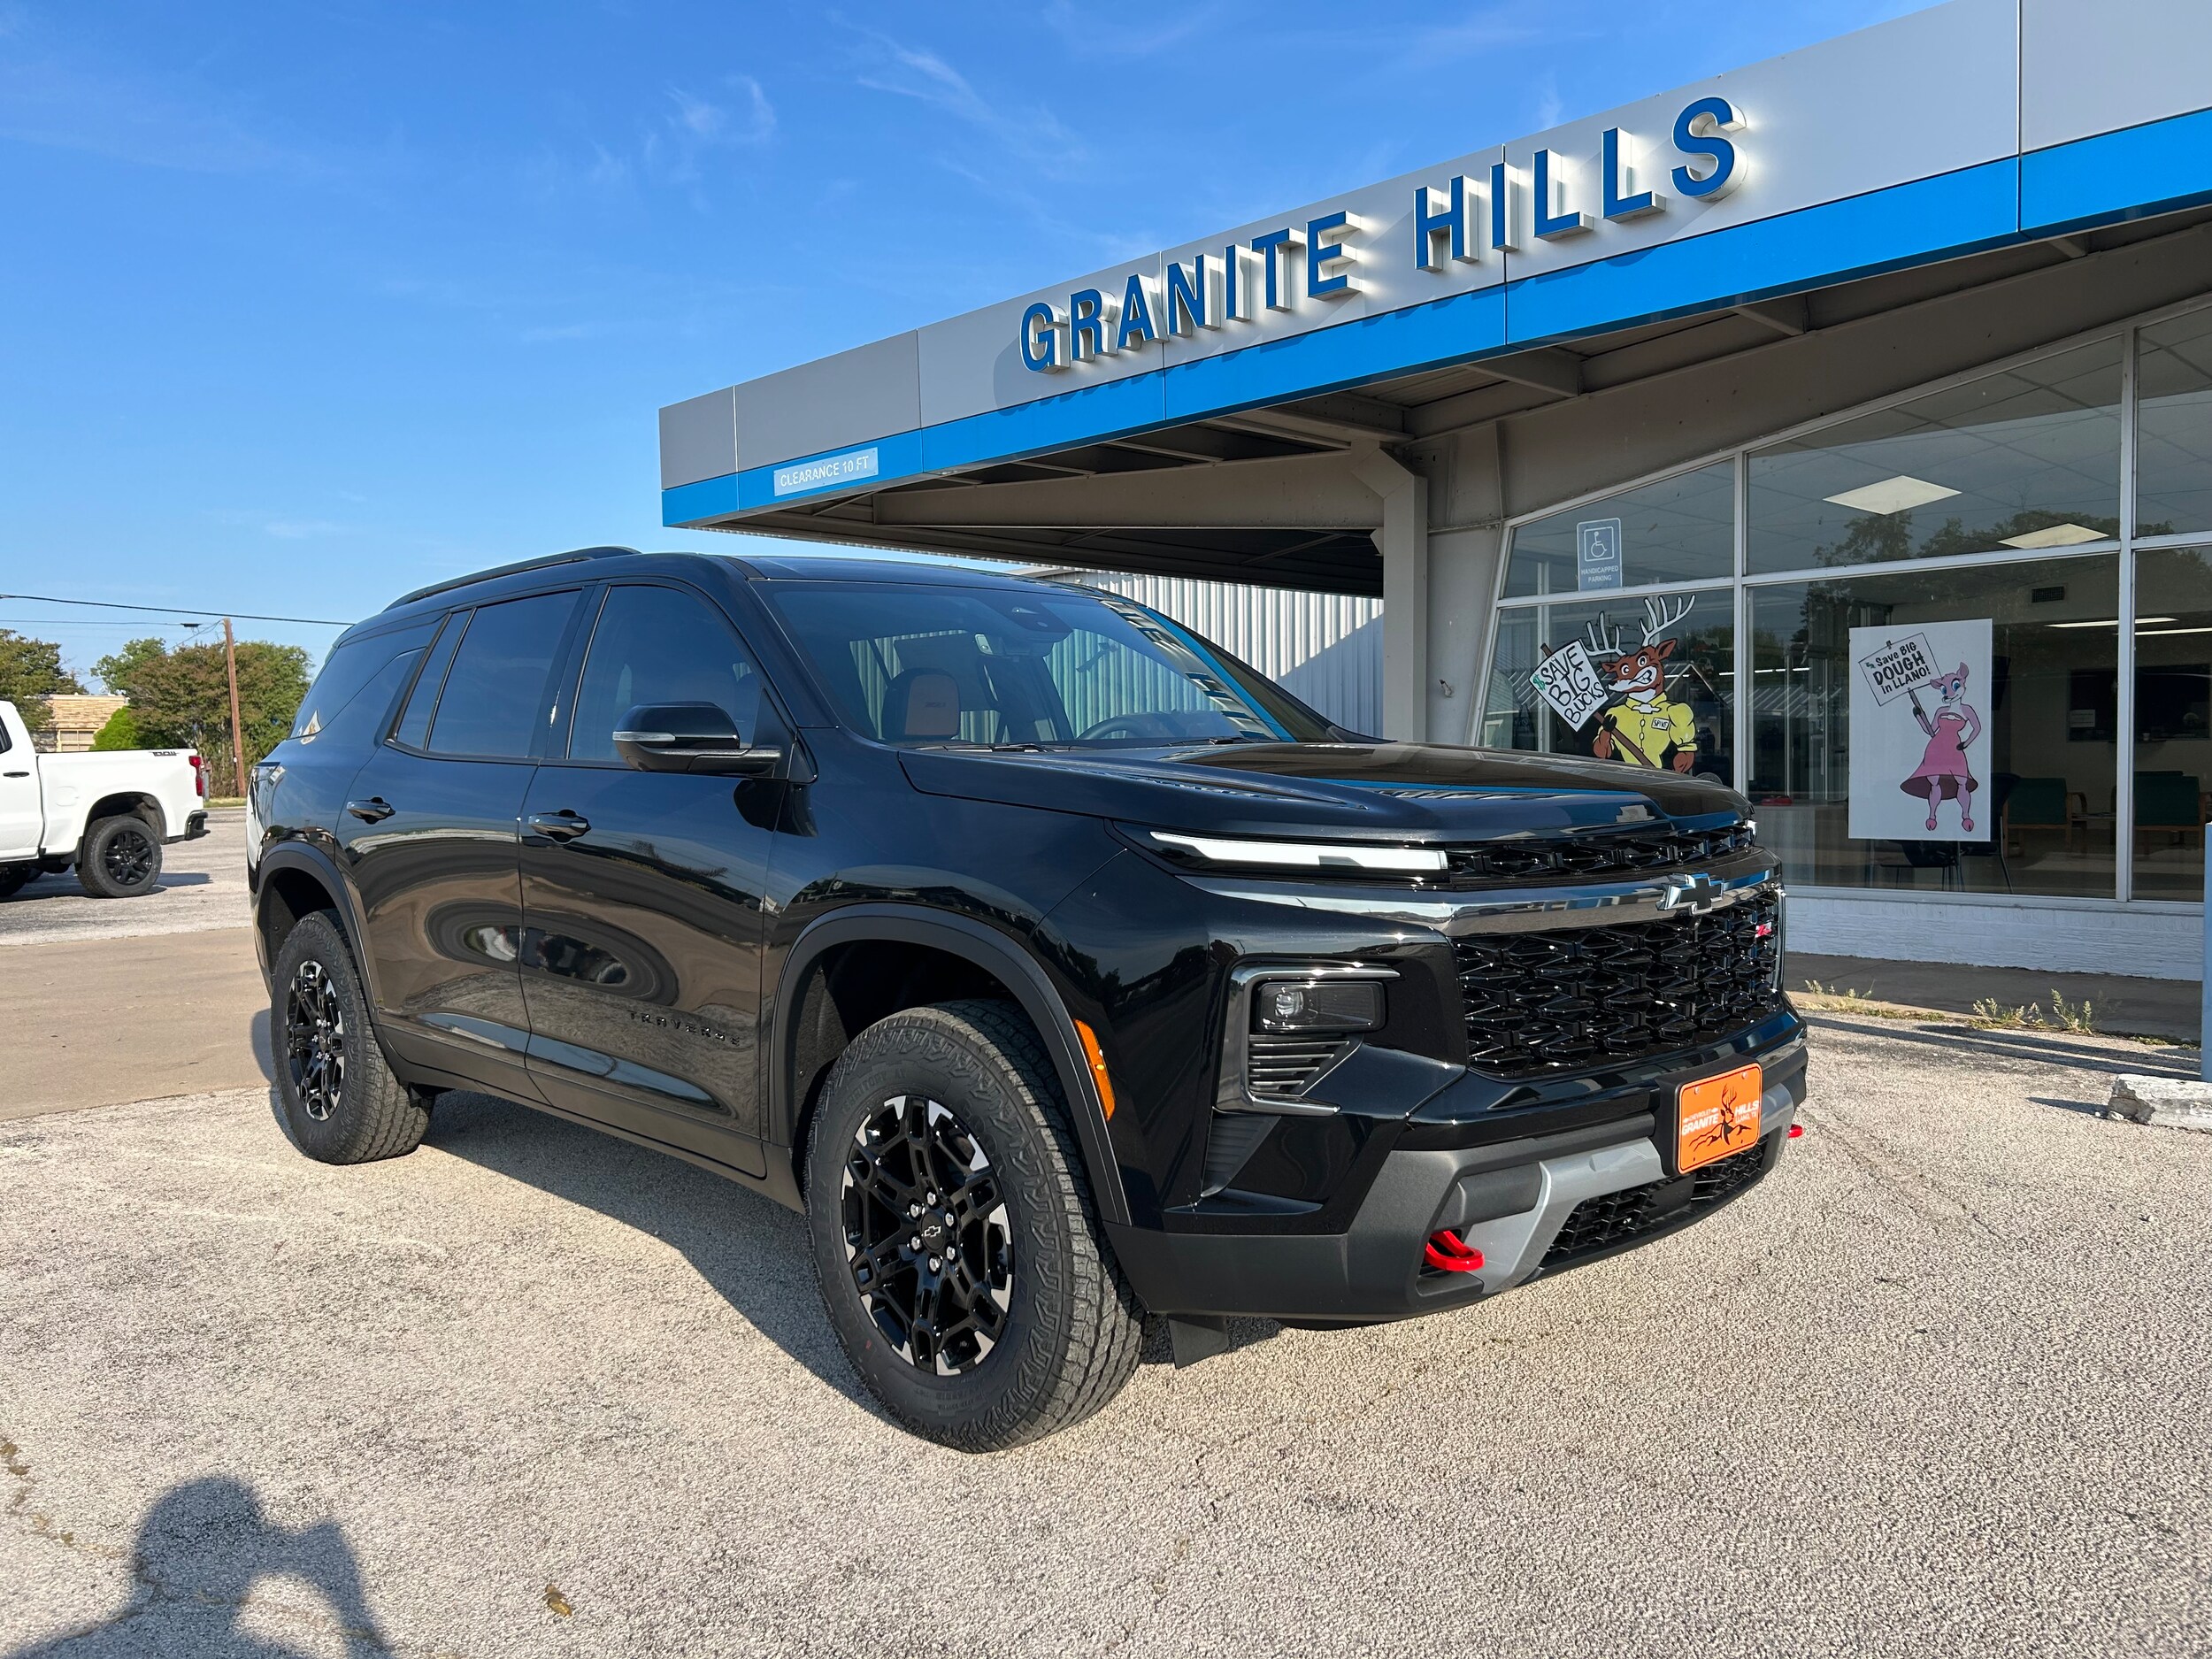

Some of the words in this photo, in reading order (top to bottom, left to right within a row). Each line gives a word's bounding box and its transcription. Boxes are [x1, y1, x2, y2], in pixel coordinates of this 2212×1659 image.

[1019, 211, 1361, 374] GRANITE
[1414, 96, 1747, 274] HILLS
[780, 463, 840, 487] CLEARANCE
[842, 460, 854, 474] 10
[856, 456, 869, 471] FT
[1581, 565, 1619, 575] HANDICAPPED
[1587, 574, 1612, 583] PARKING
[1540, 645, 1584, 686] SAVE
[1872, 650, 1926, 686] DOUGH
[1875, 651, 1900, 667] Save
[1900, 641, 1917, 656] BIG
[1548, 666, 1590, 707] BIG
[1881, 684, 1893, 695] in
[1892, 664, 1932, 689] LLANO!
[1564, 681, 1605, 724] BUCKS
[627, 1010, 741, 1047] TRAVERSE
[1682, 1113, 1718, 1136] GRANITE
[1734, 1100, 1759, 1117] HILLS
